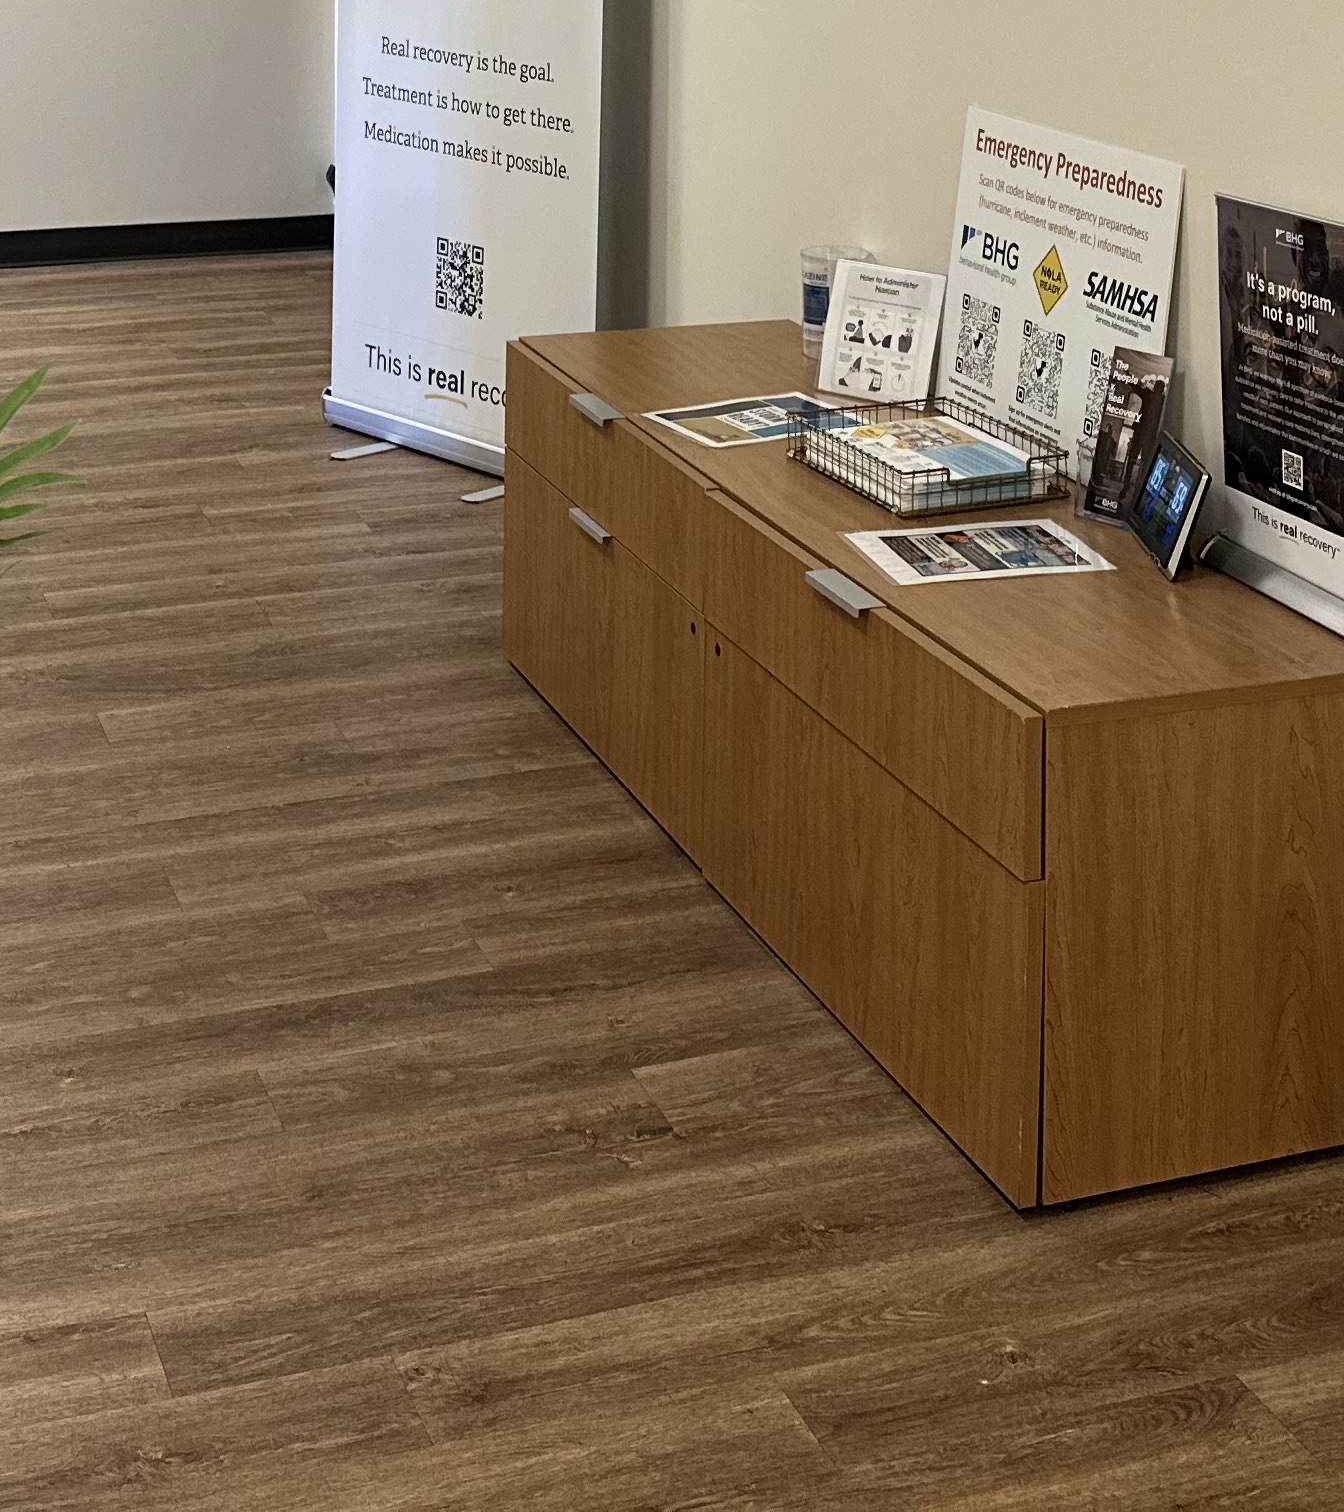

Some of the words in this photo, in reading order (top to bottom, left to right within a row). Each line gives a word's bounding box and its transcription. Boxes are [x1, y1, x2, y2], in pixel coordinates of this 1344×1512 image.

[381, 36, 409, 59] Real
[413, 45, 473, 74] recovery
[477, 51, 488, 70] is
[492, 55, 516, 76] the
[520, 63, 554, 83] goal.
[363, 77, 433, 108] Treatment
[436, 90, 448, 109] is
[451, 92, 482, 116] how
[485, 100, 500, 119] to
[503, 105, 526, 127] get
[530, 109, 574, 134] there.
[364, 121, 439, 153] Medication
[442, 134, 488, 163] makes
[491, 147, 502, 166] it
[506, 151, 570, 180] possible.
[976, 128, 1053, 178] Emergency
[1056, 152, 1163, 209] Preparedness
[979, 173, 994, 188] Scan
[1006, 184, 1024, 199] codes
[1026, 190, 1046, 206] below
[1047, 195, 1057, 209] for
[1058, 202, 1097, 225] emergency
[1098, 215, 1149, 241] preparedness
[982, 232, 1020, 270] BHG
[1097, 237, 1143, 264] information.
[1286, 231, 1304, 246] BHG
[1039, 279, 1061, 295] READY
[1041, 266, 1062, 283] NOLA
[1247, 271, 1265, 292] It's
[1267, 281, 1275, 295] a
[1278, 284, 1336, 316] program,
[1083, 271, 1159, 322] SAMHSA
[1262, 305, 1283, 323] not
[1285, 312, 1293, 326] a
[1297, 313, 1319, 335] pill.
[365, 343, 402, 376] This
[408, 354, 422, 382] is
[428, 367, 464, 395] real
[1113, 371, 1138, 385] People
[1106, 404, 1142, 423] Recovery
[1252, 506, 1269, 526] This
[1271, 515, 1278, 530] is
[1280, 522, 1298, 538] real
